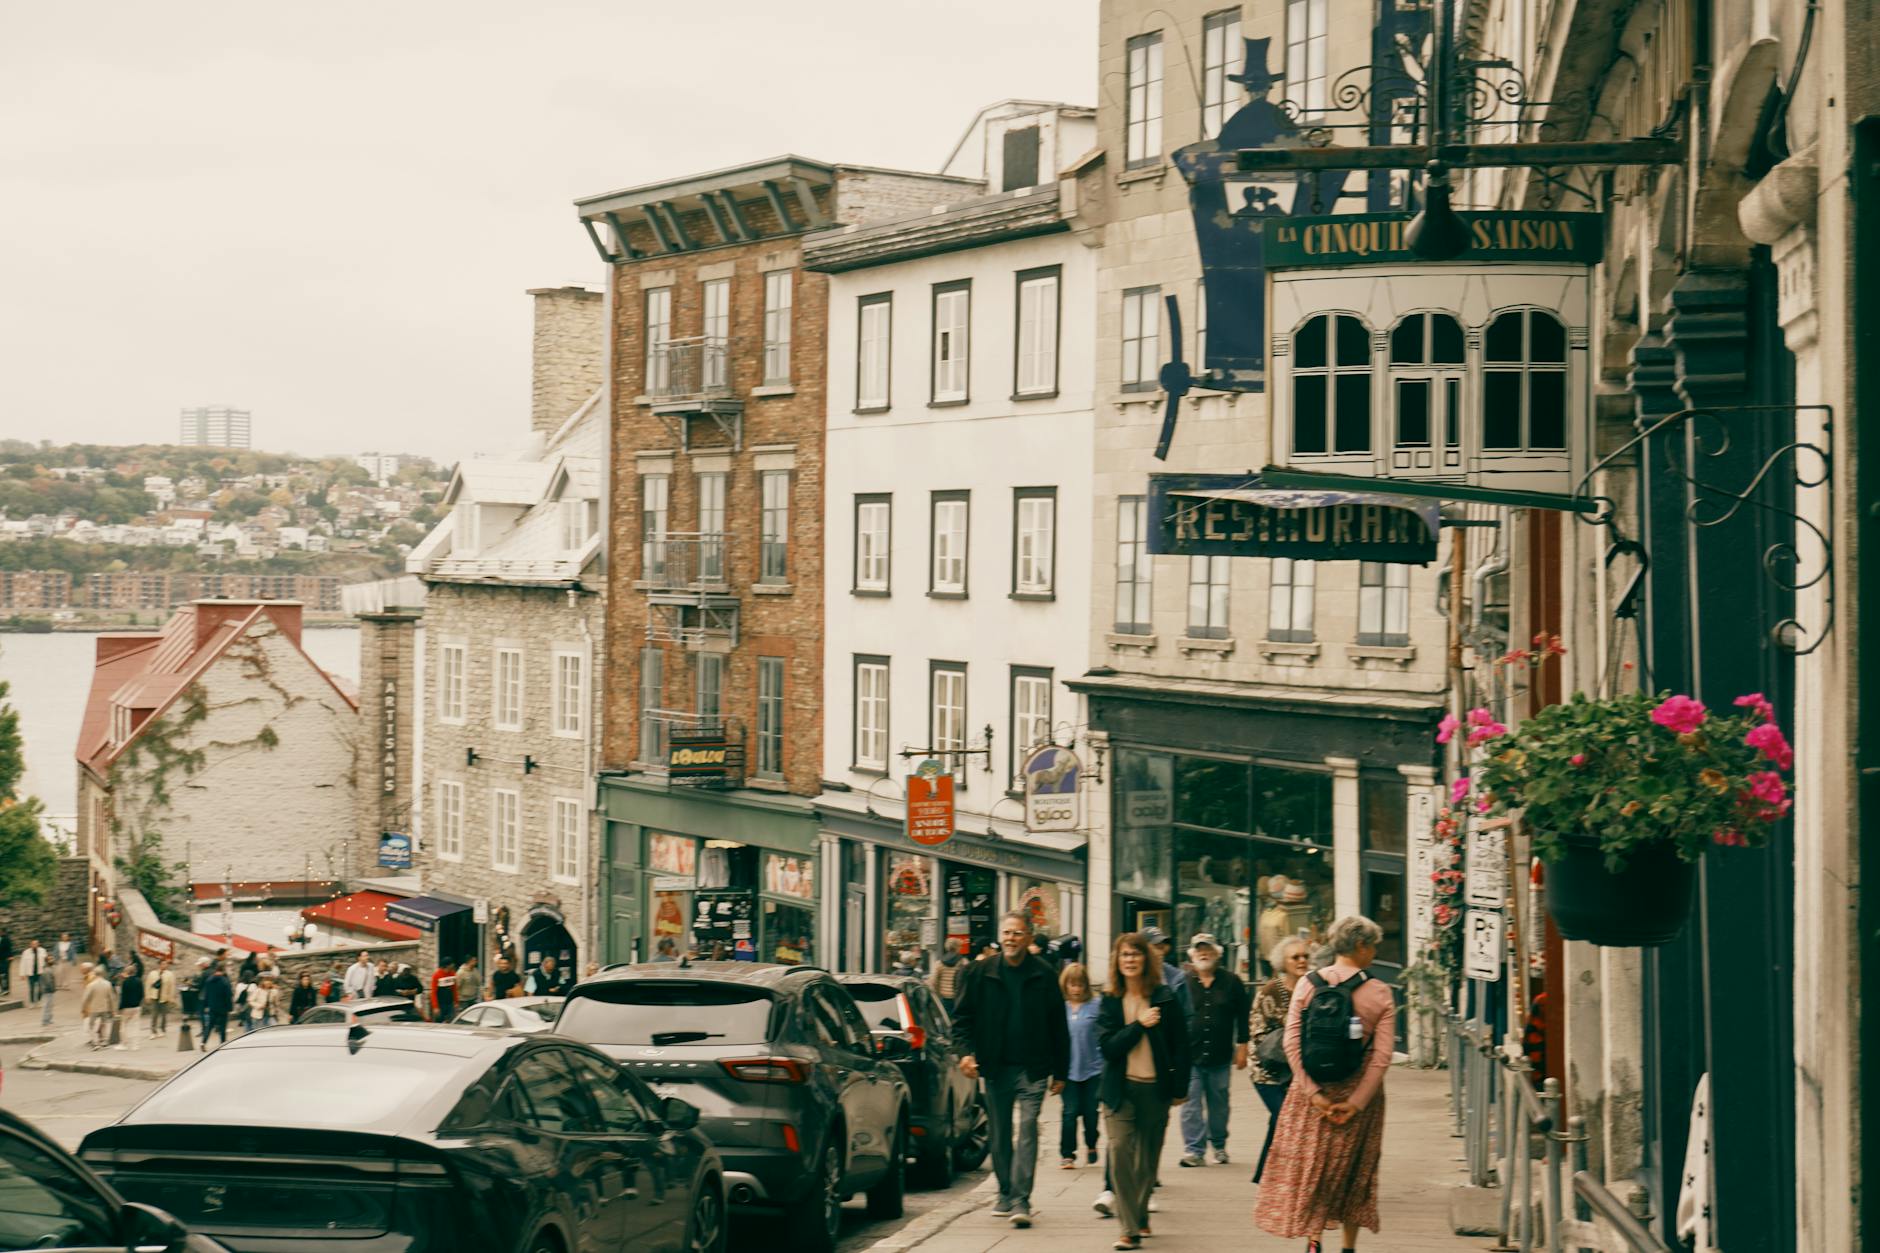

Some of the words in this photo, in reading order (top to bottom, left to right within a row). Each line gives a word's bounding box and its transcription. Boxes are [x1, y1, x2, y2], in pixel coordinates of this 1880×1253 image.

[1278, 227, 1298, 242] LA
[1303, 218, 1409, 255] CINQUI
[1471, 219, 1575, 250] SAISON
[384, 682, 395, 792] ARTISANS
